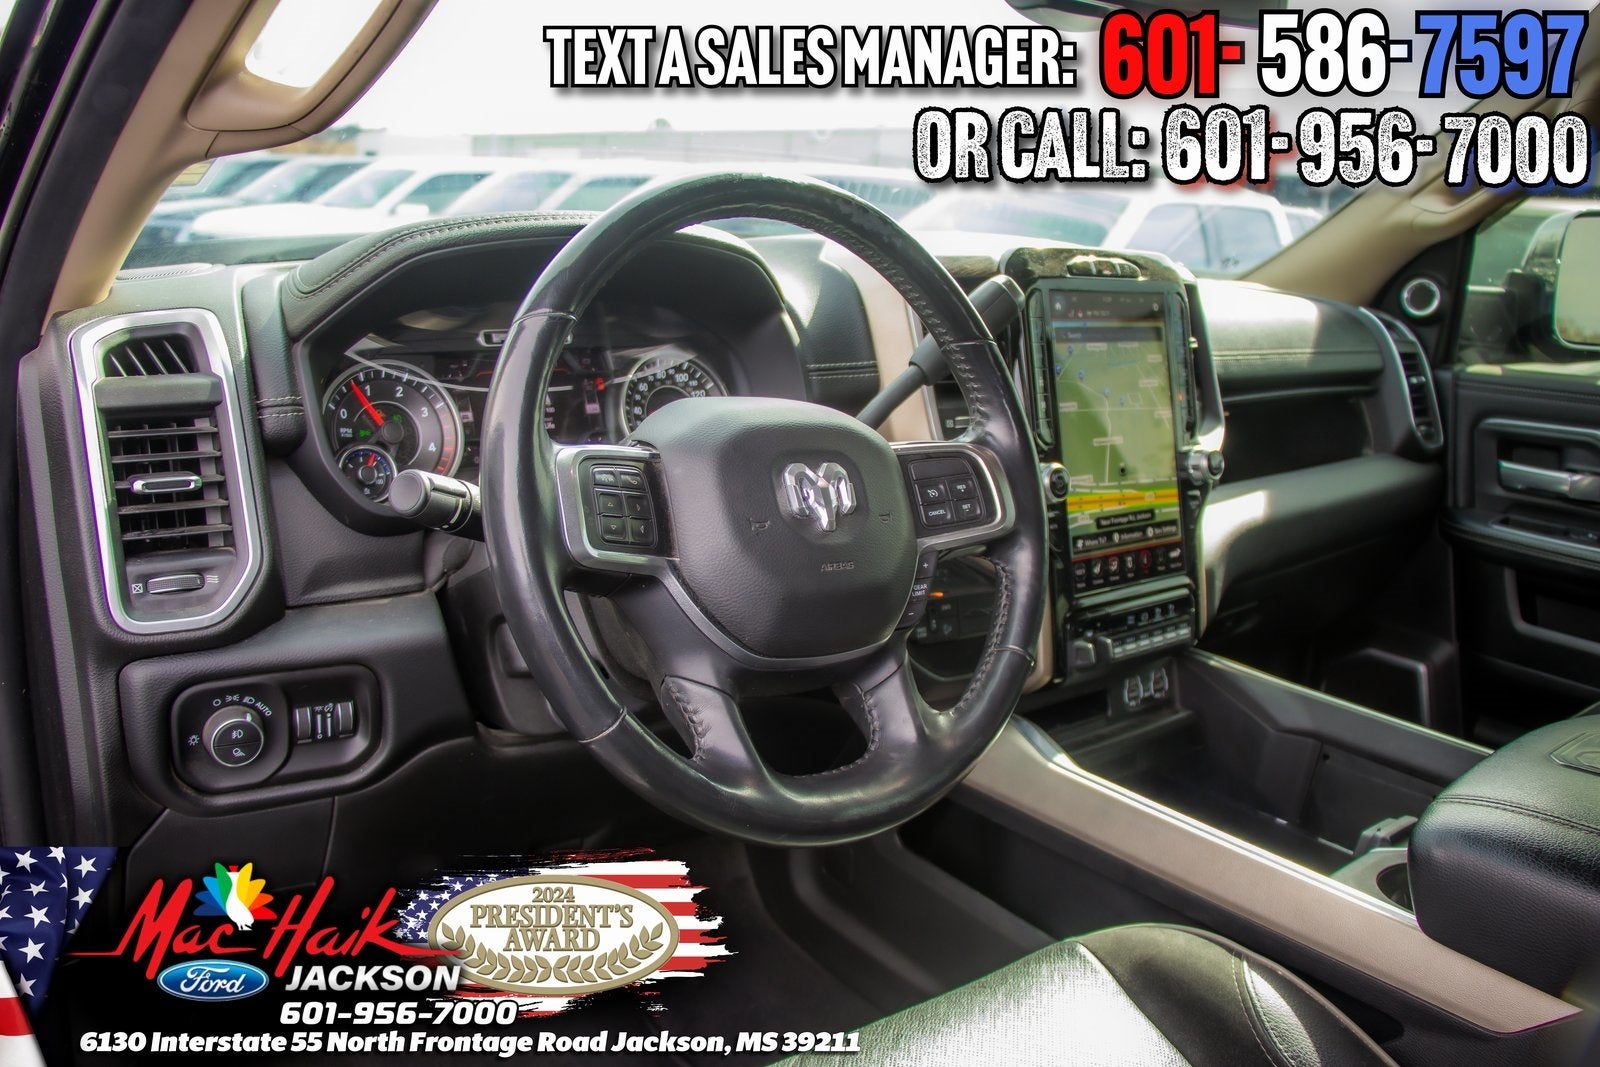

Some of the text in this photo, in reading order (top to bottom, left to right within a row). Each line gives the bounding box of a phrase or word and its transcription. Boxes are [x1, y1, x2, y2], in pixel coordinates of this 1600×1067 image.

[675, 372, 689, 382] 100
[364, 385, 371, 396] 1
[395, 386, 404, 397] 2
[639, 383, 648, 391] 60
[340, 408, 348, 419] 0
[420, 407, 429, 418] 3
[428, 442, 437, 452] 4
[928, 509, 946, 517] CANCEL
[255, 703, 272, 717] AUTO
